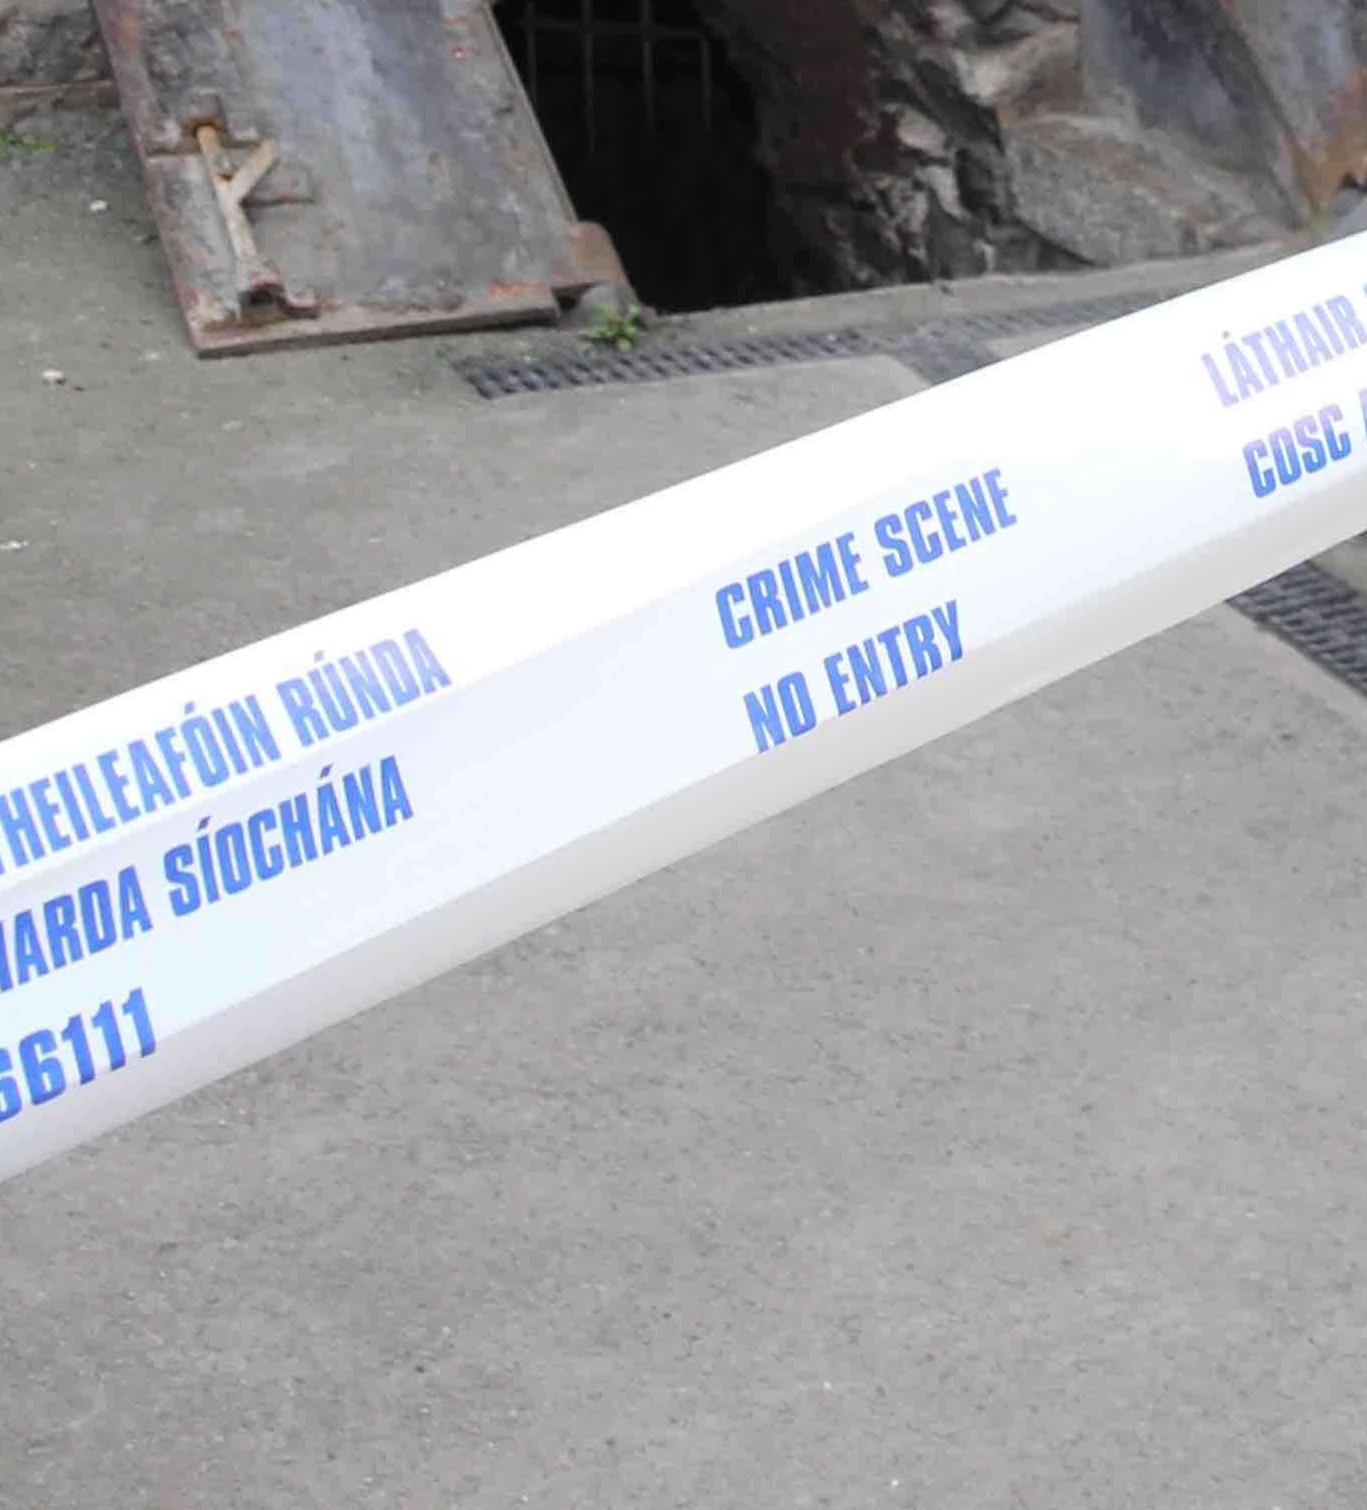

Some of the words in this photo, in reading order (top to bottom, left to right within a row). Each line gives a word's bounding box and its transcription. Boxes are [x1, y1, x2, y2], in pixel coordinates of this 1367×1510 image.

[1242, 402, 1353, 499] COSC
[715, 531, 870, 650] CRIME
[874, 467, 1017, 578] SCENE
[275, 628, 452, 748] RÚNDA
[743, 670, 818, 754] NO
[823, 599, 963, 717] ENTRY
[163, 755, 414, 917] SÍOCHÁNA
